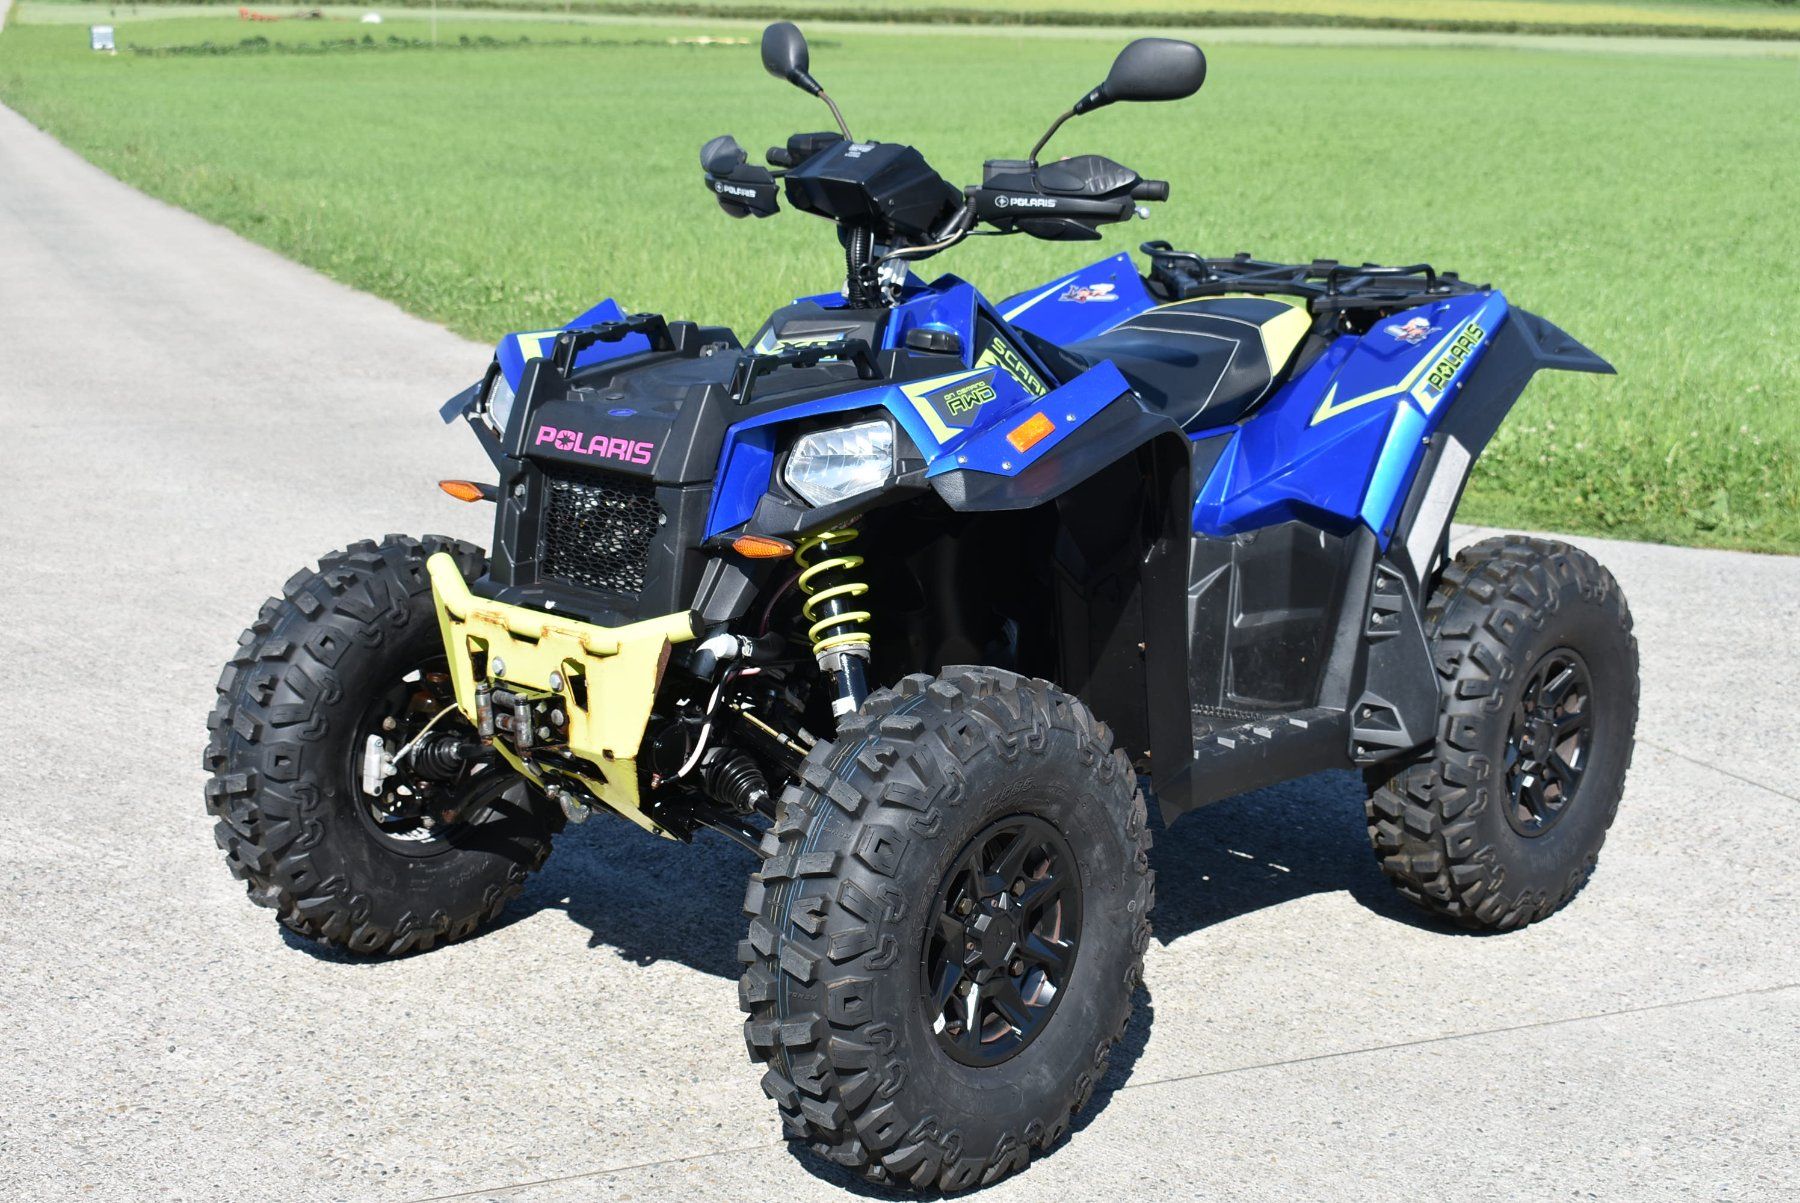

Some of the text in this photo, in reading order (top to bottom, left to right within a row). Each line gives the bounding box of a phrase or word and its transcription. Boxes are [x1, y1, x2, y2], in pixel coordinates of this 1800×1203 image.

[723, 184, 756, 198] POLARIS
[1010, 197, 1058, 208] POLARIS
[1428, 323, 1485, 390] POLARIS
[946, 385, 997, 416] AWD
[535, 425, 654, 465] POLARIS
